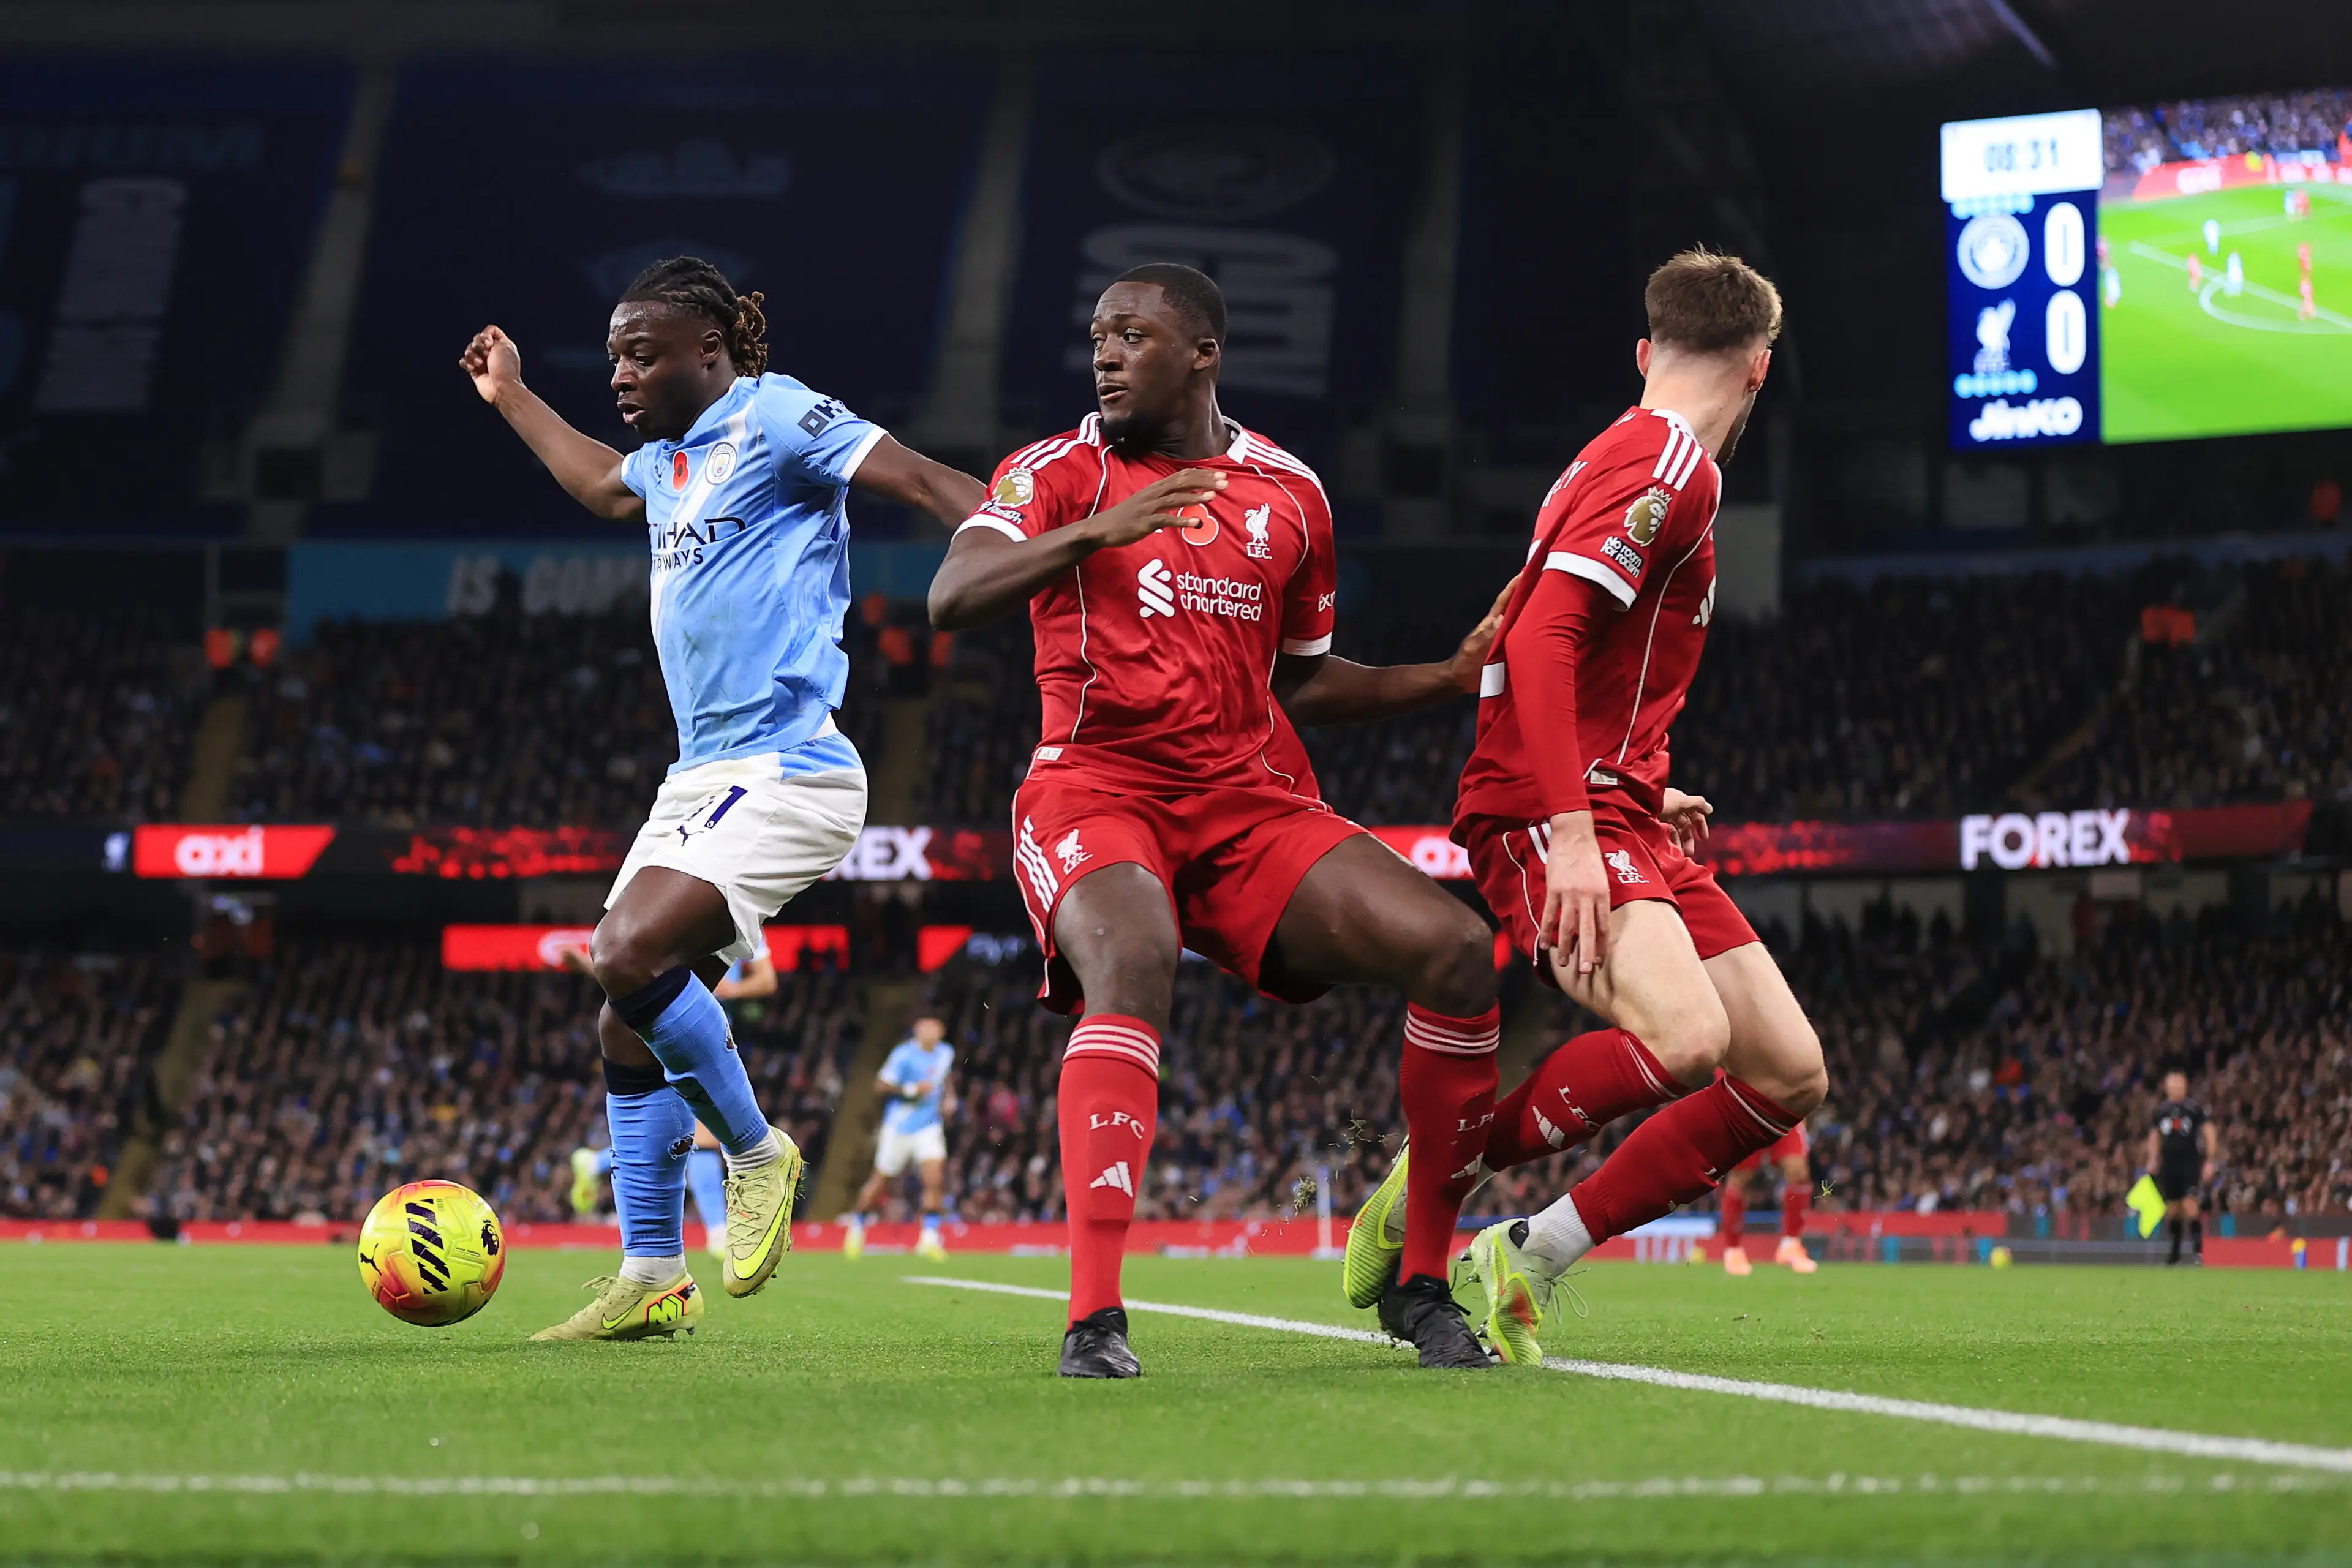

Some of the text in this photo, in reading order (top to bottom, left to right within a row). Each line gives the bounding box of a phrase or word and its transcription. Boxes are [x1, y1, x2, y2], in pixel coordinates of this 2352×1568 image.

[2045, 202, 2085, 287] 0
[2046, 290, 2086, 375] 0
[652, 547, 704, 576] IRWAYS
[1620, 545, 1642, 567] room
[1177, 571, 1262, 601] standard
[1180, 591, 1262, 622] chartered
[1961, 808, 2130, 871] FOREX
[1089, 1111, 1144, 1139] LFC
